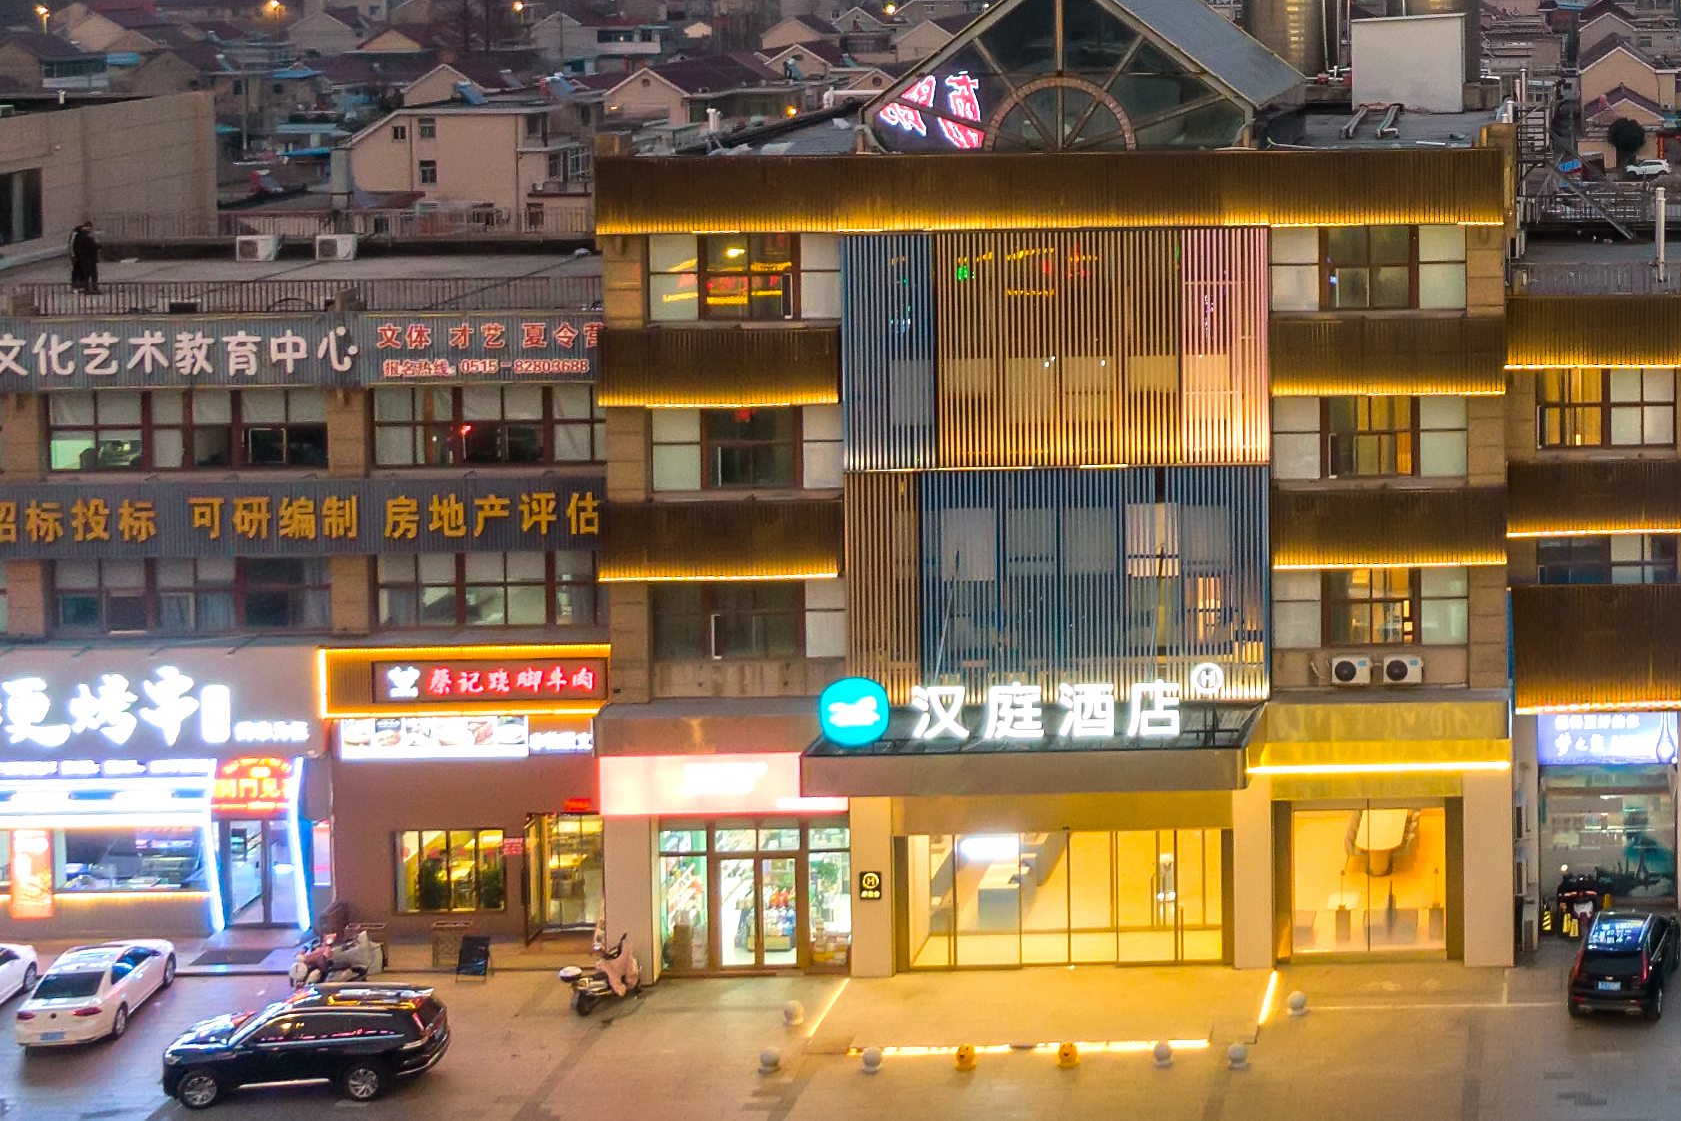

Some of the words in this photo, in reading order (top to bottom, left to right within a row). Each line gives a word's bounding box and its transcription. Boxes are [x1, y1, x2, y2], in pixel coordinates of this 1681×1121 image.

[0, 326, 358, 377] 文化艺术教育中心
[376, 323, 431, 349] 文体
[450, 323, 506, 349] 才艺
[187, 495, 358, 540] 可研编制
[384, 492, 599, 540] 房地产评估
[0, 666, 199, 747] 更烤串
[911, 678, 1183, 740] 汉庭酒店
